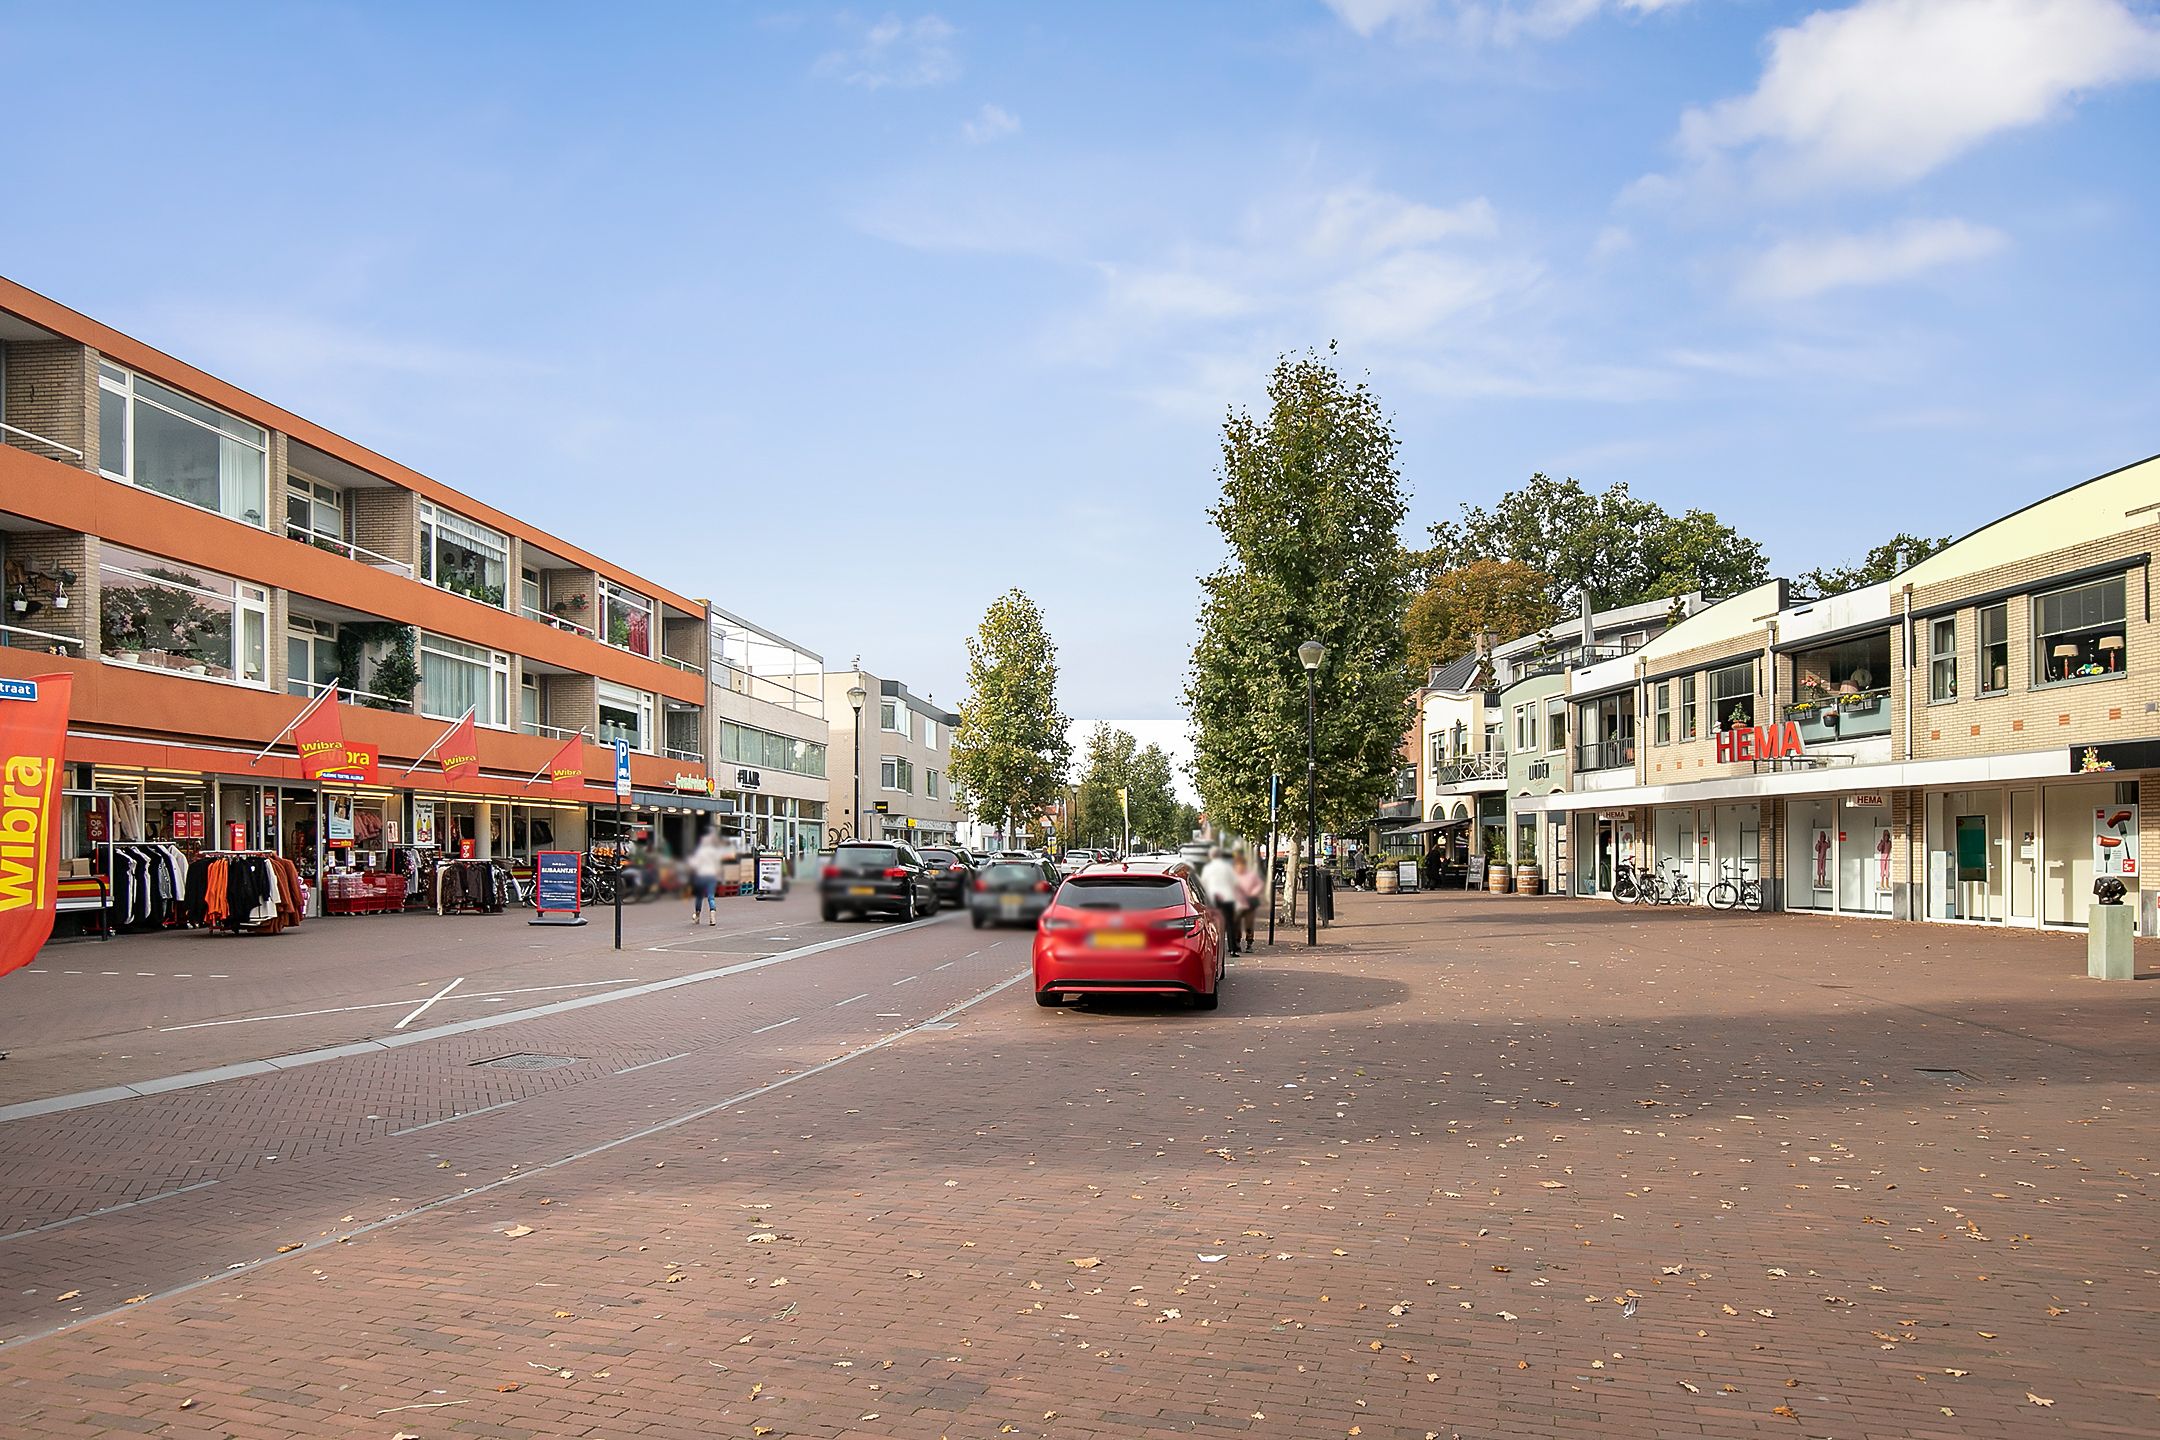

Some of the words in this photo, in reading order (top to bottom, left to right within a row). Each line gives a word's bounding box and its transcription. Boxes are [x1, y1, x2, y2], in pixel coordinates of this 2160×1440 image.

[1716, 721, 1804, 763] HEMA
[620, 742, 627, 764] P
[1857, 796, 1883, 804] HEMA
[1605, 811, 1625, 819] HEMA
